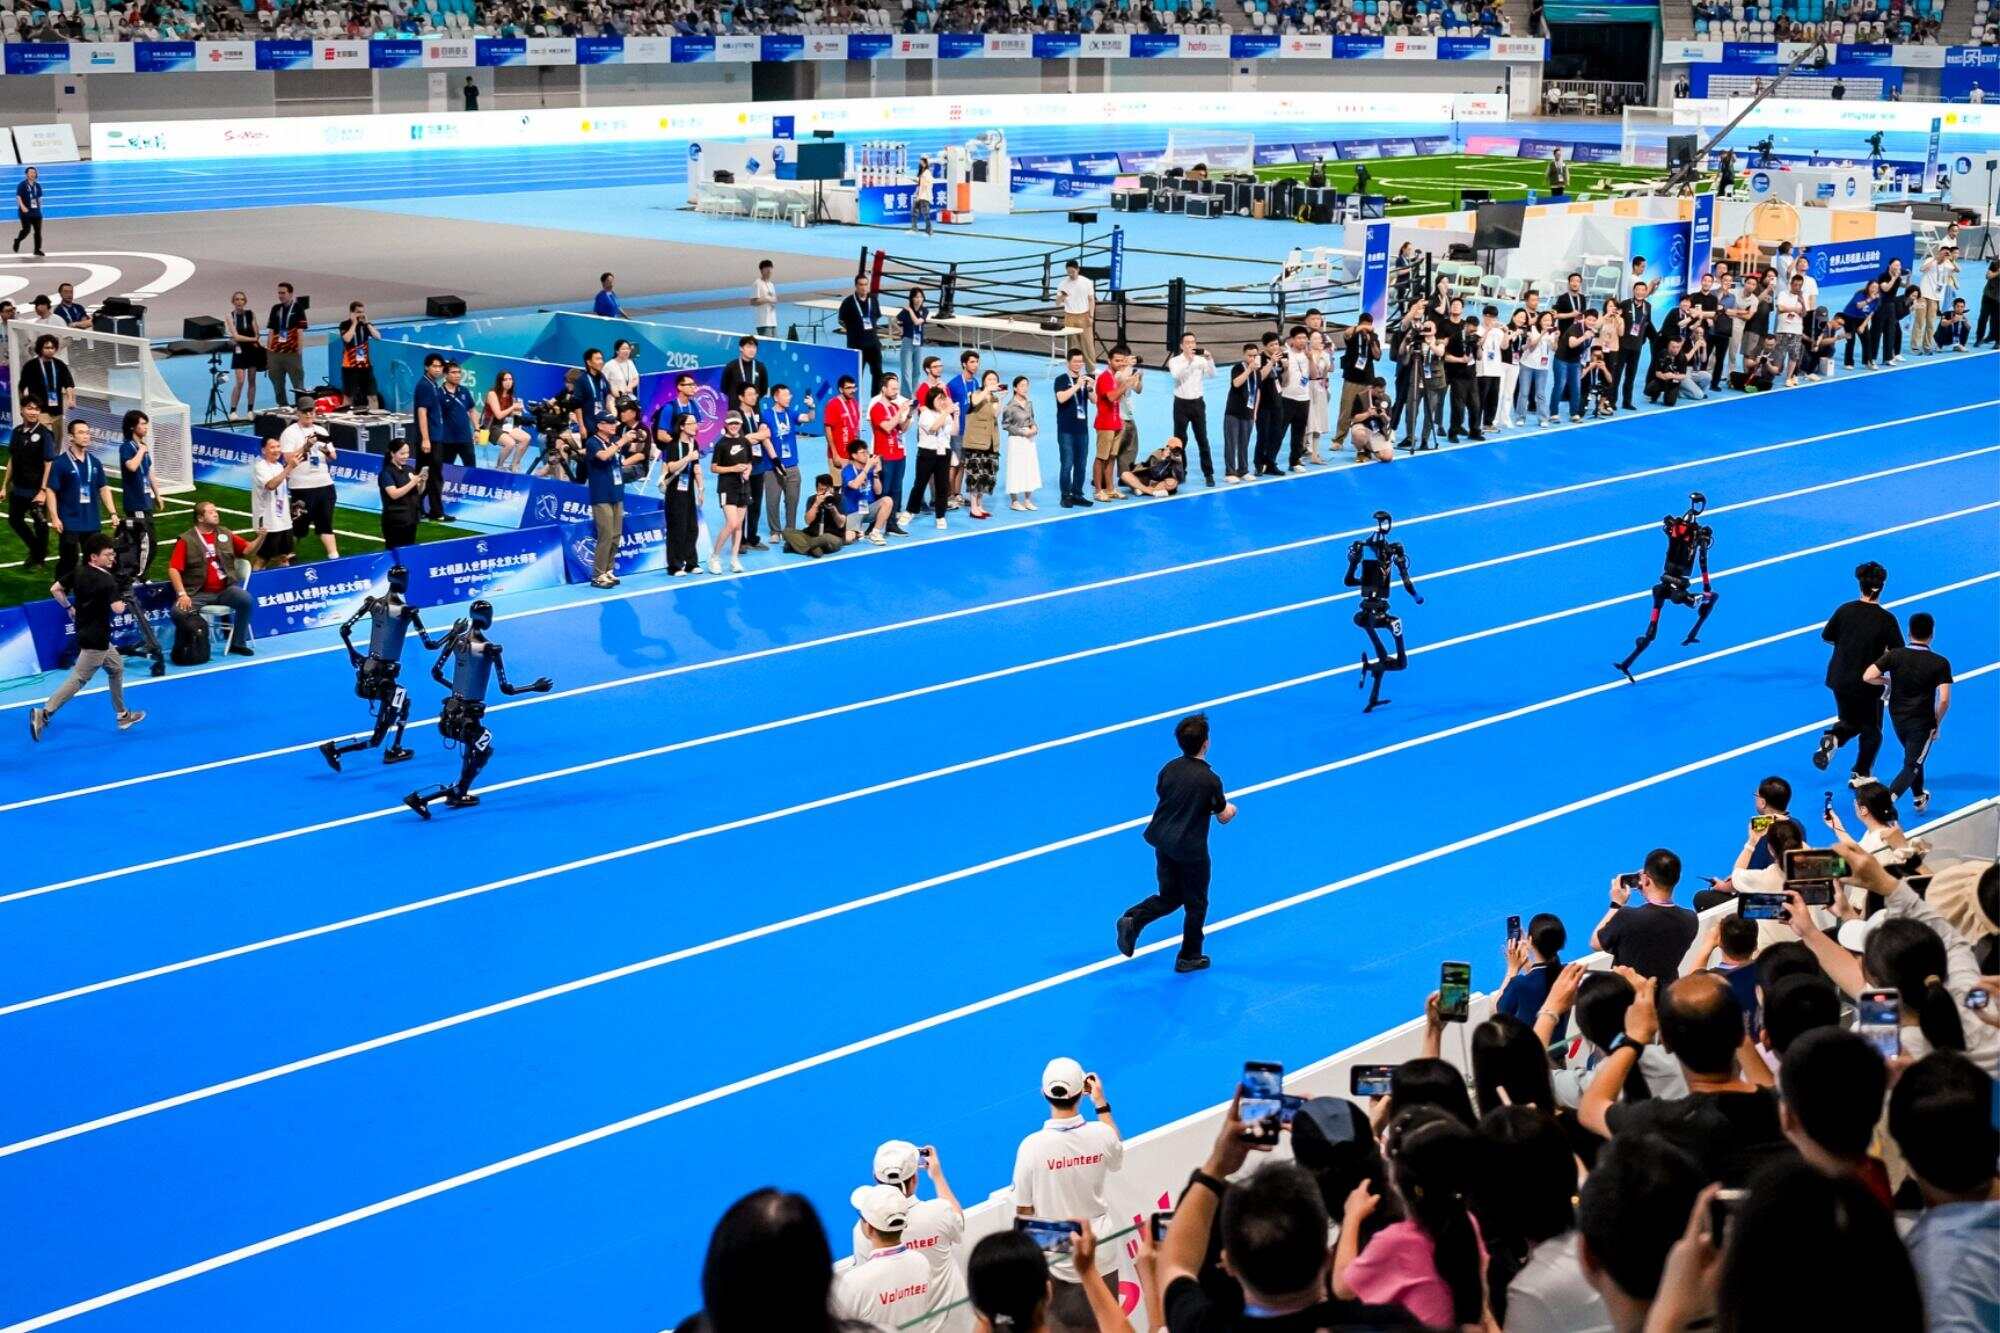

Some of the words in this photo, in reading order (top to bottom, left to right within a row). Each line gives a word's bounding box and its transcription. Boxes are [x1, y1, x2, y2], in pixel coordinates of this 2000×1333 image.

[666, 352, 699, 369] 2025
[1047, 1153, 1103, 1170] Volunteer
[906, 1235, 939, 1250] nteer
[880, 1283, 928, 1305] Voluntee
